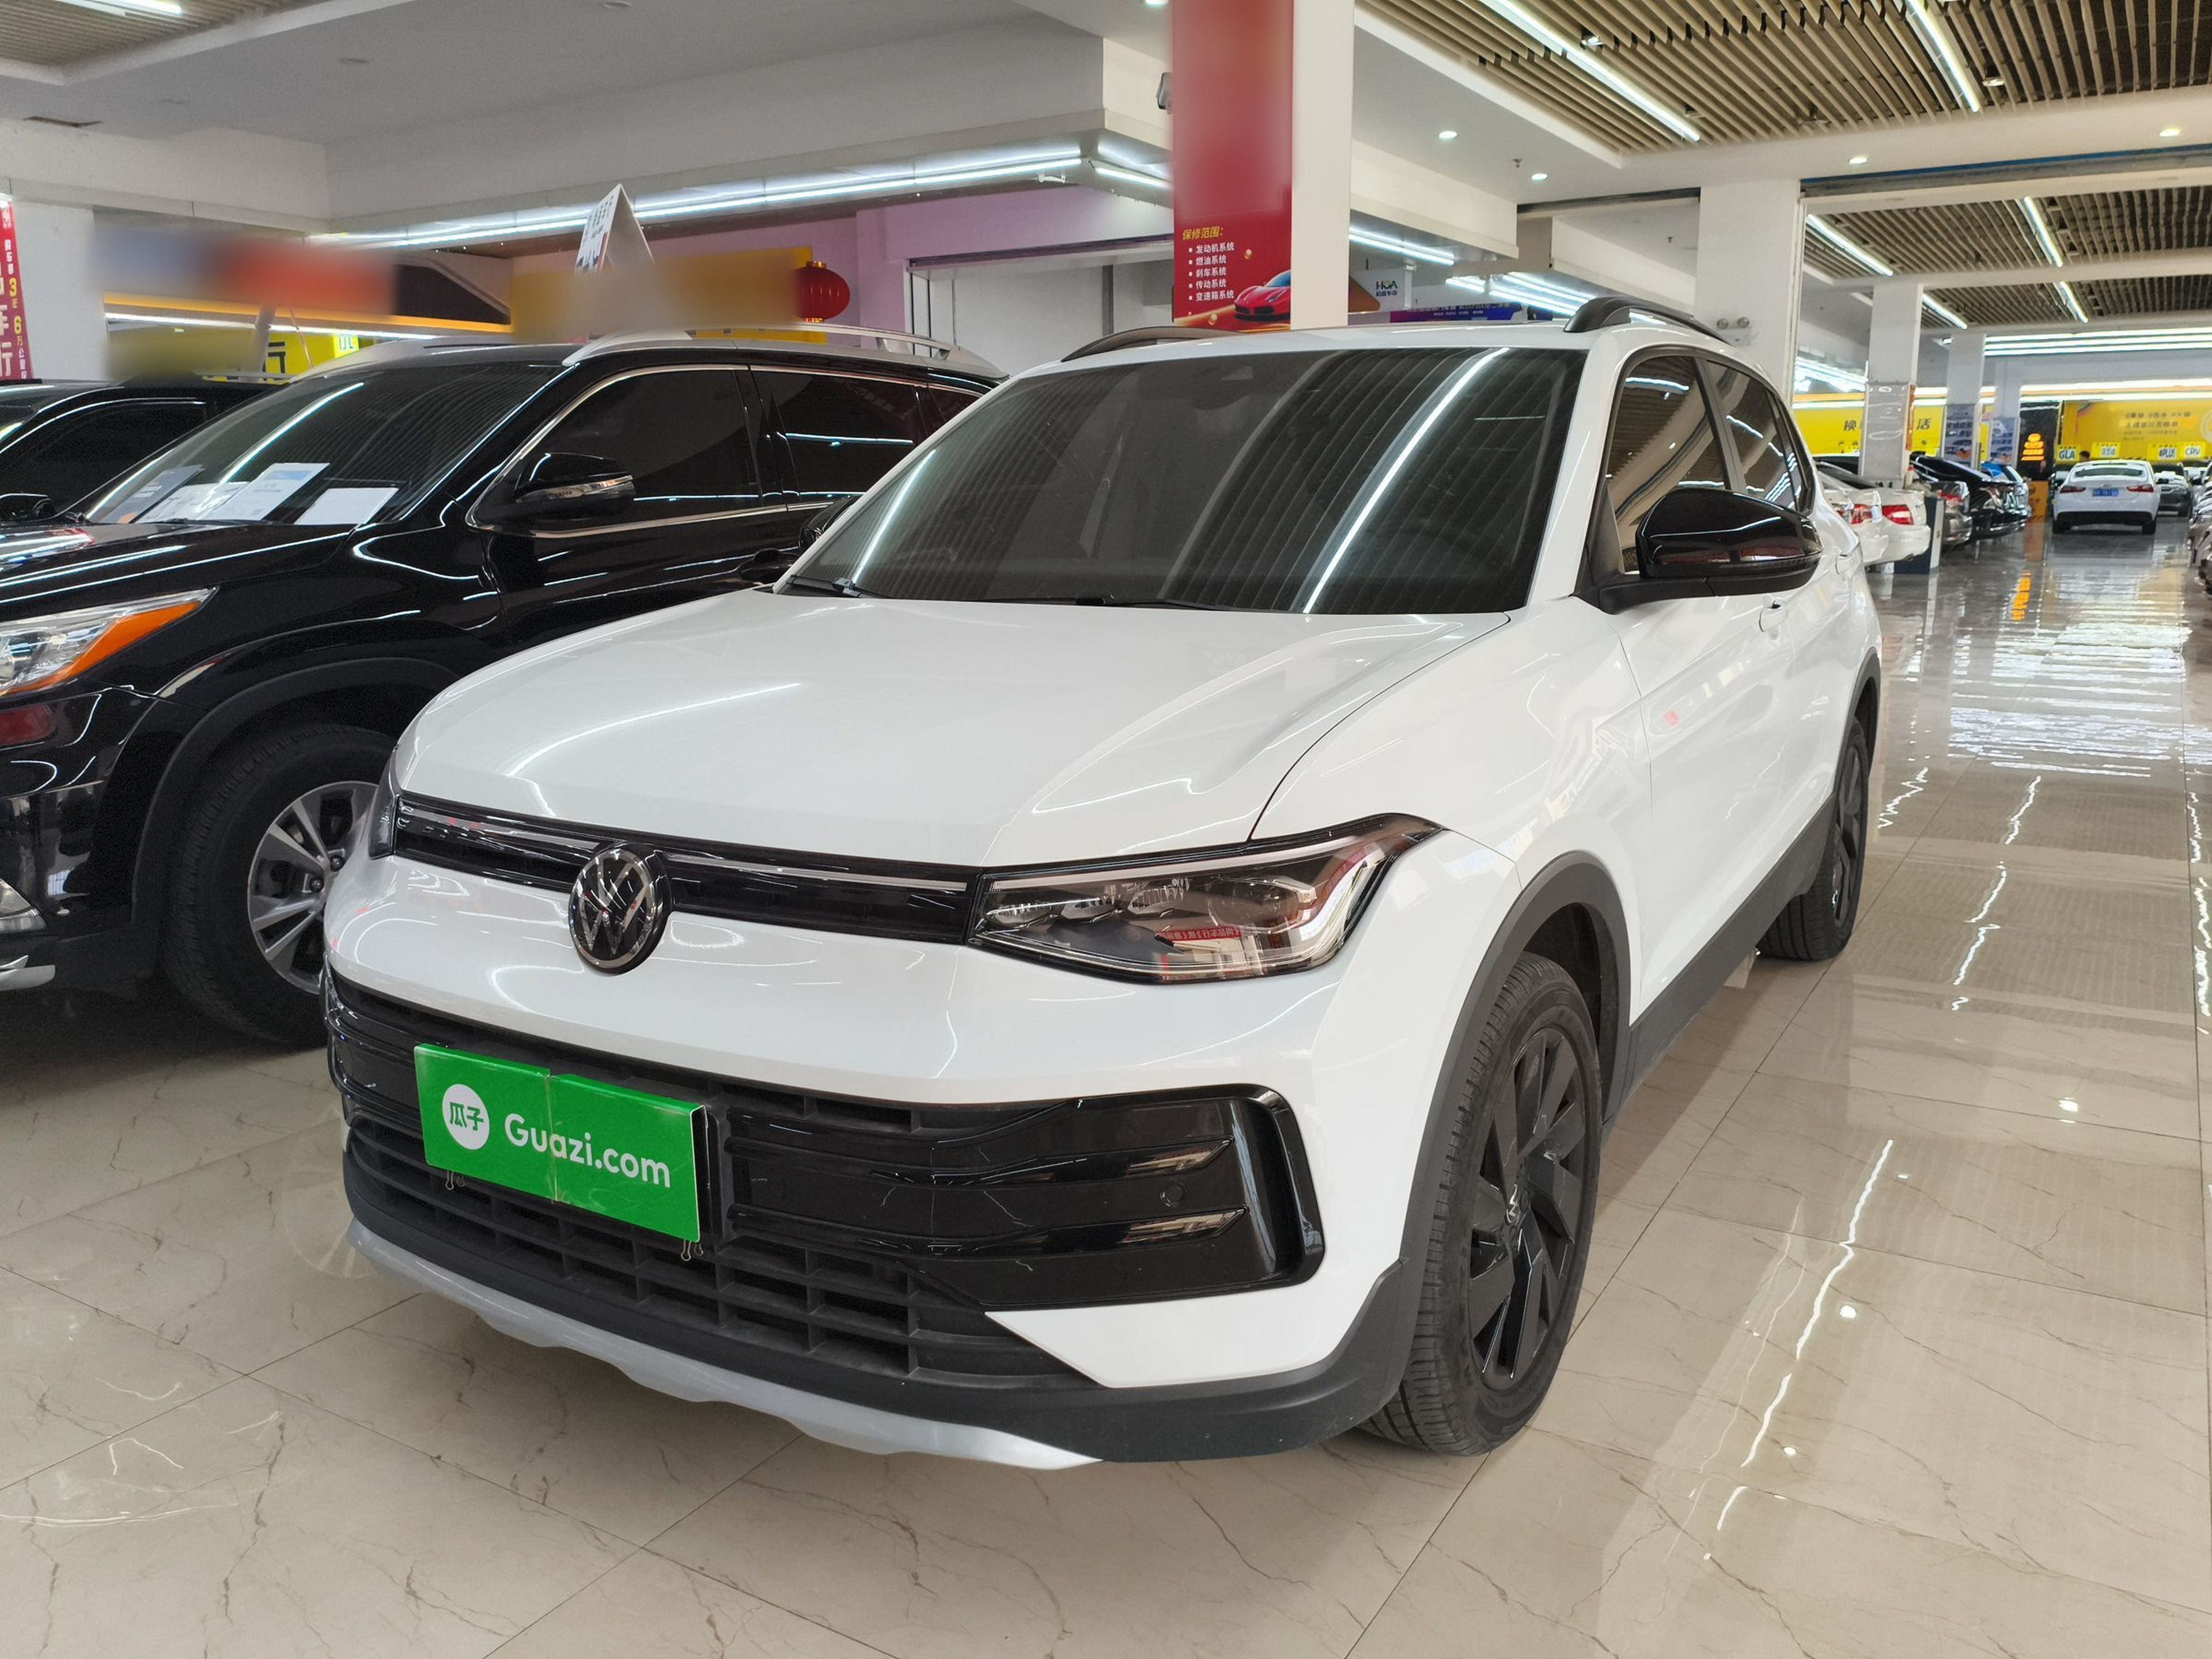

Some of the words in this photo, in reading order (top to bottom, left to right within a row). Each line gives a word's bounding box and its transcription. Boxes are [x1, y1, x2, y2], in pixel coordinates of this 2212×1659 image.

[1196, 242, 1234, 254] 发动机系统
[1196, 255, 1226, 266] 燃油系统
[1196, 267, 1226, 278] 刹车系统
[1196, 279, 1226, 290] 传动系统
[1196, 290, 1234, 301] 变速箱系统
[1916, 418, 1931, 430] 活
[449, 1101, 484, 1131] 瓜子
[505, 1113, 671, 1188] Guazi.com
